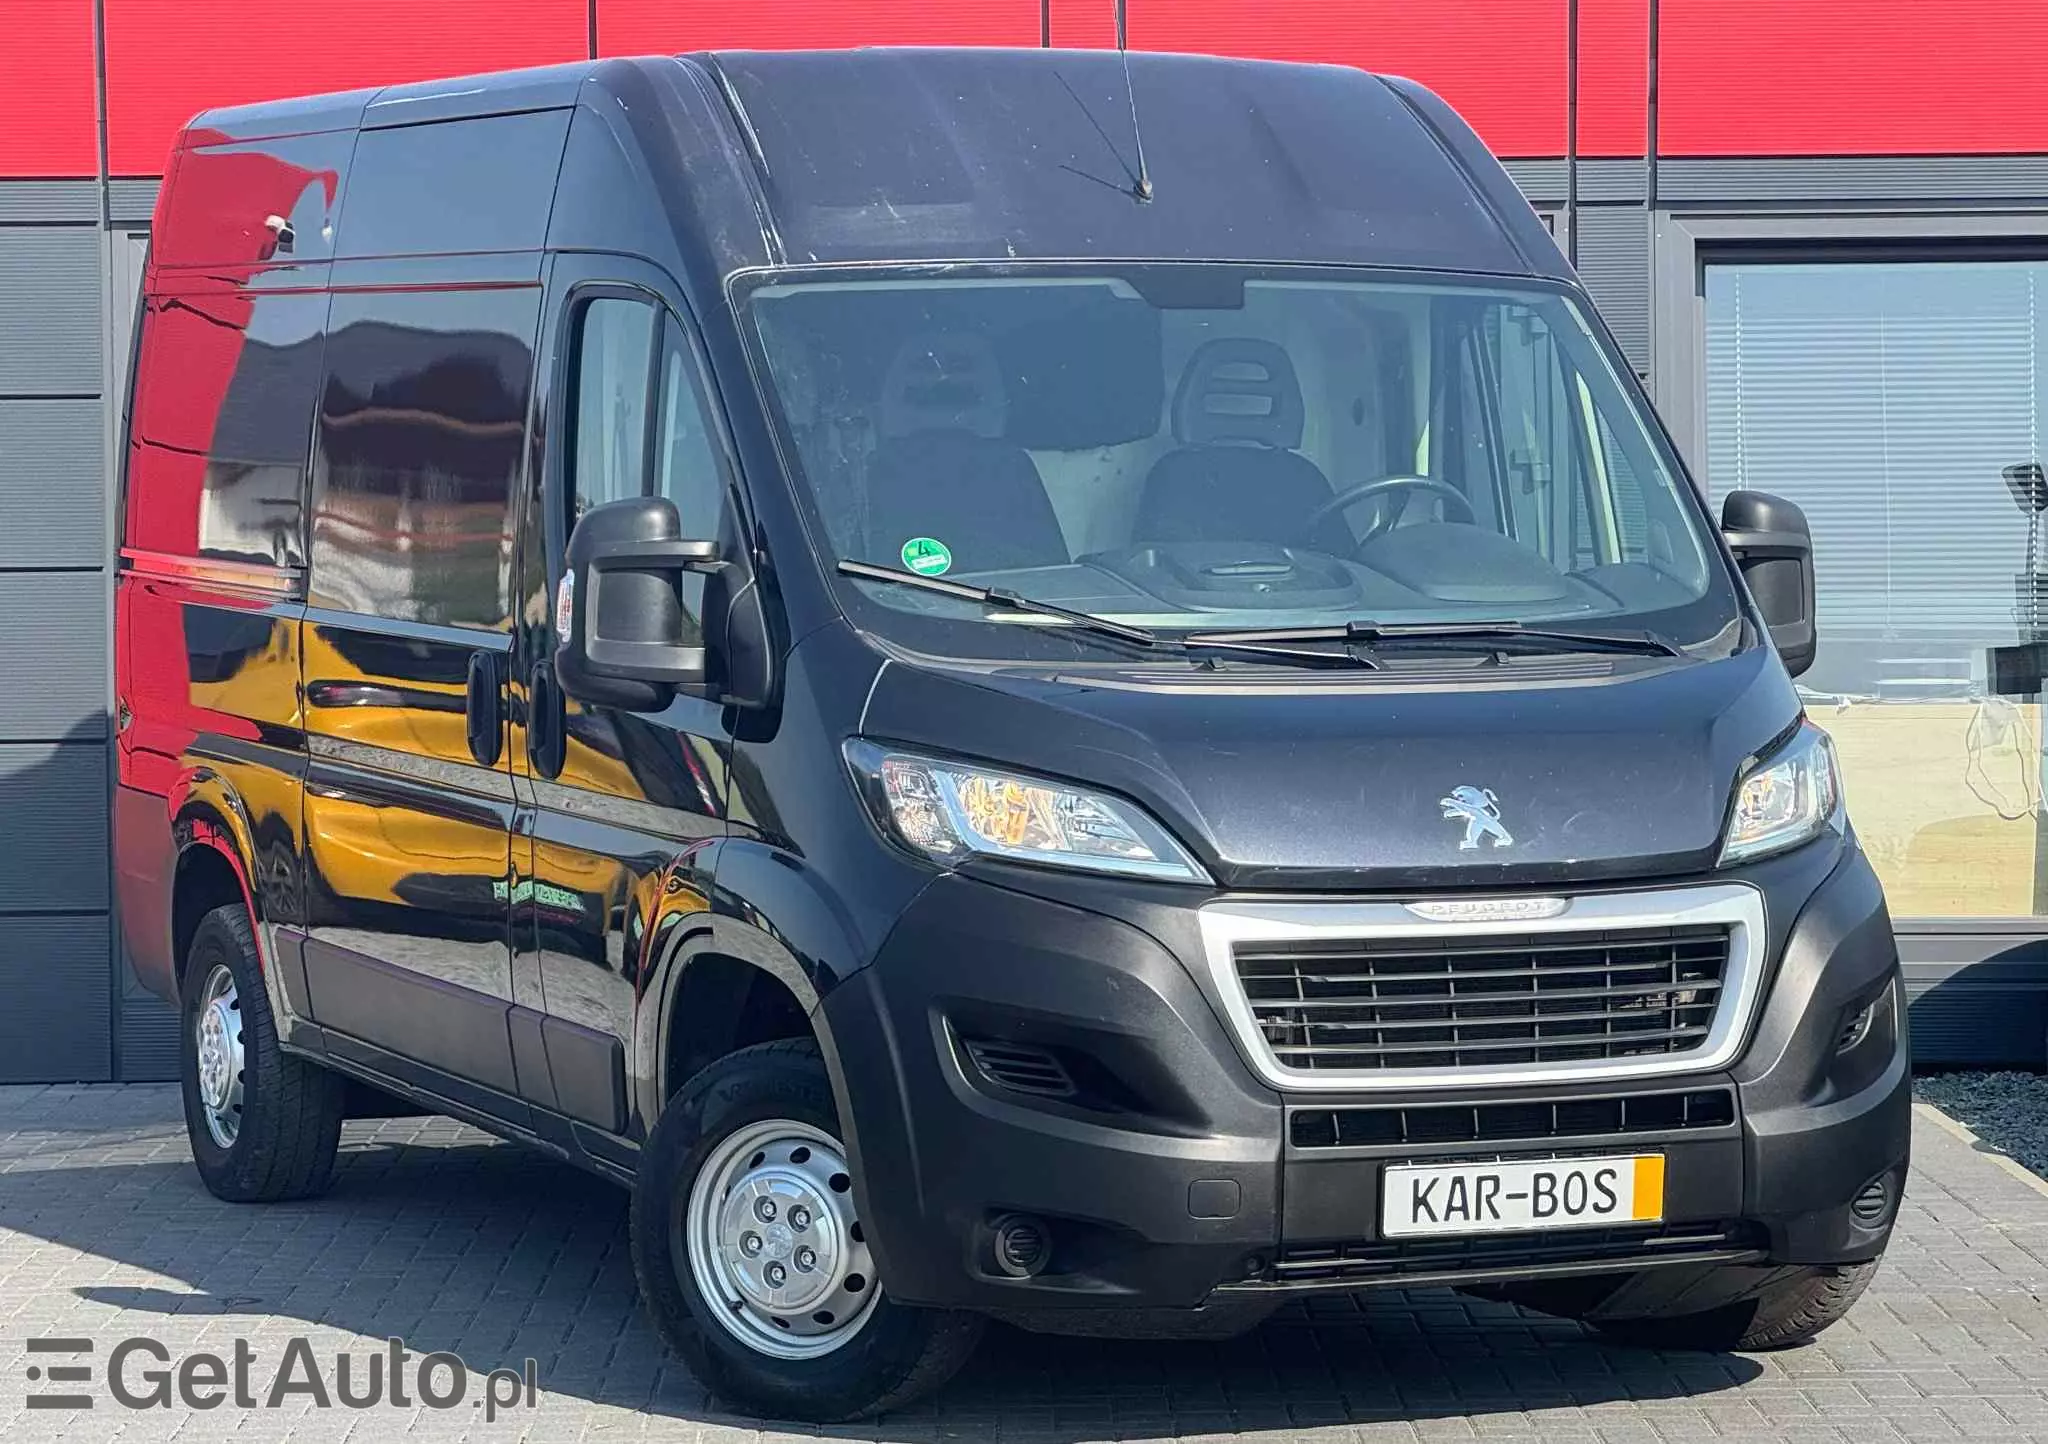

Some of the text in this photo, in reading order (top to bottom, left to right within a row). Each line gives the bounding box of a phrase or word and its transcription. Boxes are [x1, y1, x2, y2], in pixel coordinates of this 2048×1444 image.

[918, 541, 930, 556] 4
[1431, 901, 1545, 914] PEUGEOT
[1412, 1168, 1618, 1223] KAR-BOS
